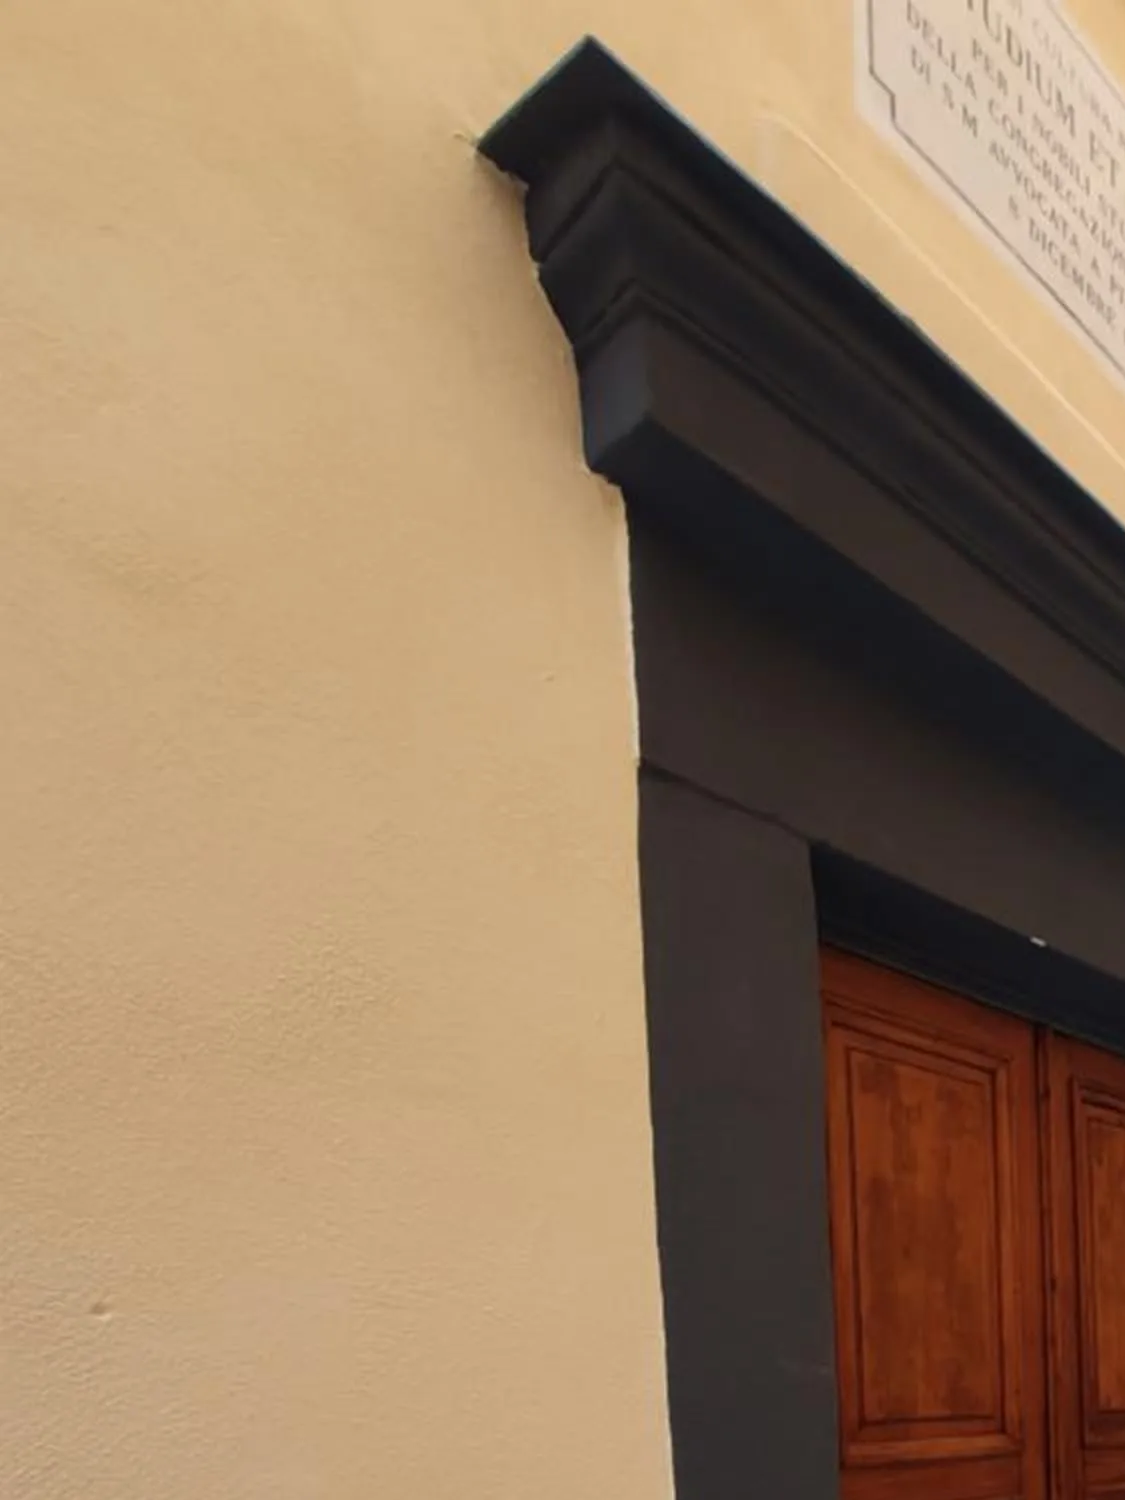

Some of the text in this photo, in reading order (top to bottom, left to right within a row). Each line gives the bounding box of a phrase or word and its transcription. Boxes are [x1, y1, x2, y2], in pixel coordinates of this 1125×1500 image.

[906, 0, 977, 101] DELLA
[911, 45, 930, 85] DI
[989, 137, 1080, 254] AVVOCATA
[1090, 253, 1102, 279] A
[972, 37, 1008, 96] PER
[1032, 110, 1090, 195] NOBILI
[1088, 129, 1121, 191] ET
[1029, 217, 1116, 331] DICEMBRE
